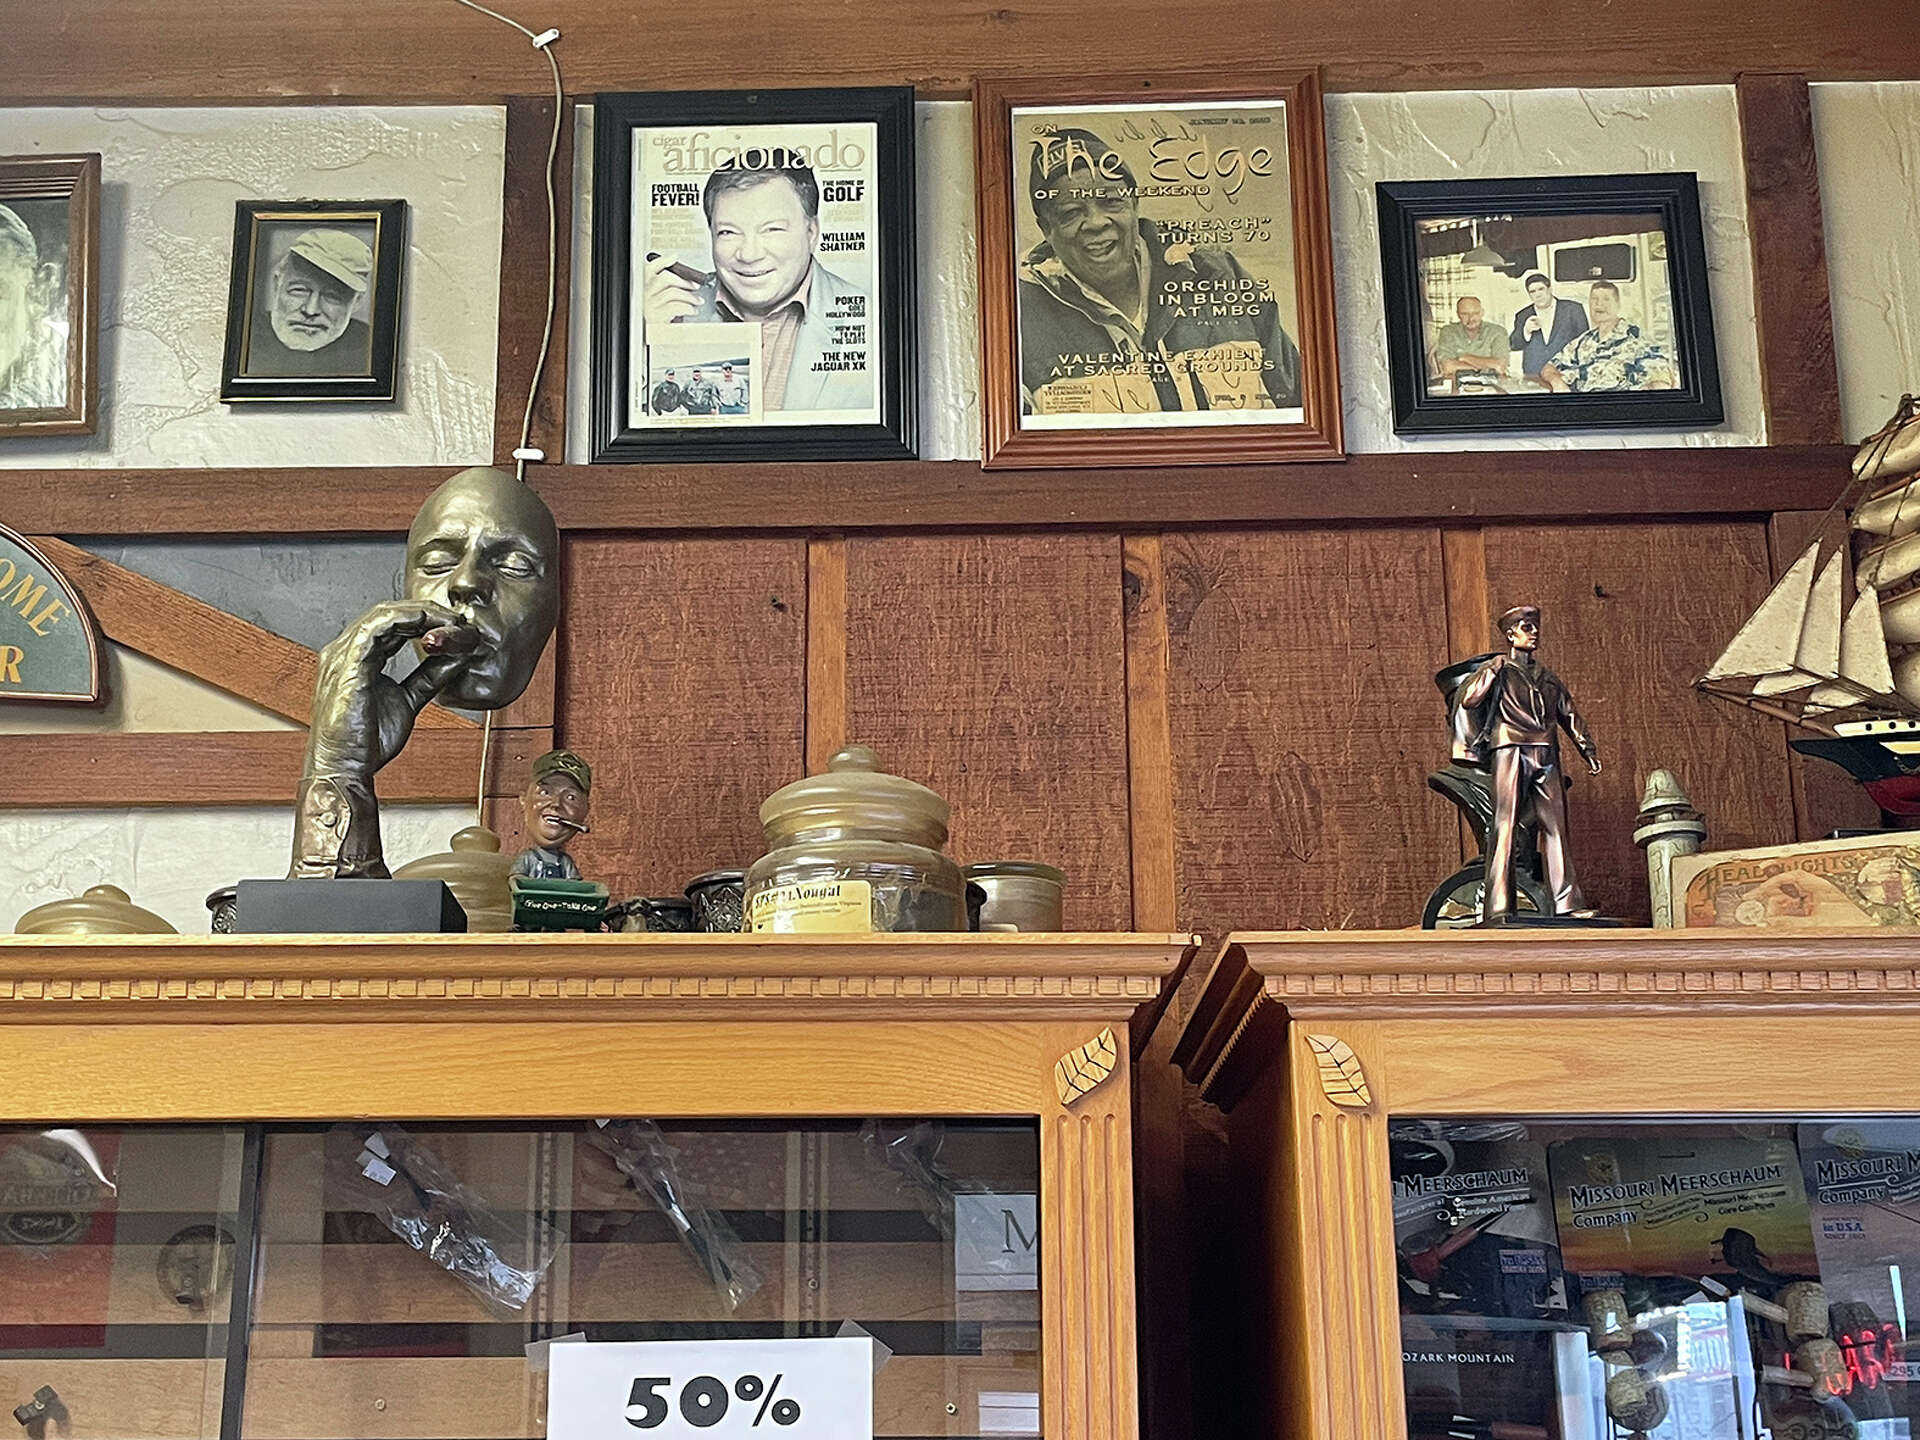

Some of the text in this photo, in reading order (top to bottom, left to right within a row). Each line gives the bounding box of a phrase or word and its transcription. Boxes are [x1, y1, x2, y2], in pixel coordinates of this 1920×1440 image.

[1031, 123, 1058, 135] ON
[652, 135, 687, 149] cigar
[663, 129, 866, 173] aficionado
[1029, 134, 1273, 196] The Edge
[652, 184, 699, 194] FOOTBALL
[823, 187, 865, 202] GOLF
[1034, 184, 1211, 200] OF THE WEEKEND
[652, 194, 699, 207] FEVER!
[822, 232, 865, 242] WILLIAM
[1158, 230, 1271, 245] TURNS 70
[820, 242, 865, 252] SHATNER
[1163, 279, 1271, 293] ORCHIDS
[835, 296, 866, 305] POKER
[1159, 291, 1275, 306] IN BLOOM
[1174, 304, 1261, 318] AT MBG
[822, 351, 866, 361] THE NEW
[1058, 348, 1266, 365] VALENTINE EXHIBIT
[811, 361, 867, 372] JAGUAR XK
[1050, 359, 1276, 378] AT SACRED GROUNDS
[796, 885, 841, 900] Nougat
[1814, 1156, 1902, 1185] MISSOURI
[1402, 1167, 1529, 1198] MEERSCHAUM
[1568, 1179, 1656, 1209] MISSOURI
[1658, 1163, 1783, 1198] MEERSCHAUM
[1818, 1186, 1887, 1206] Company
[1572, 1209, 1638, 1229] Company
[1401, 1353, 1516, 1364] OZARK MOUNTAIN
[624, 1373, 801, 1429] 50%
